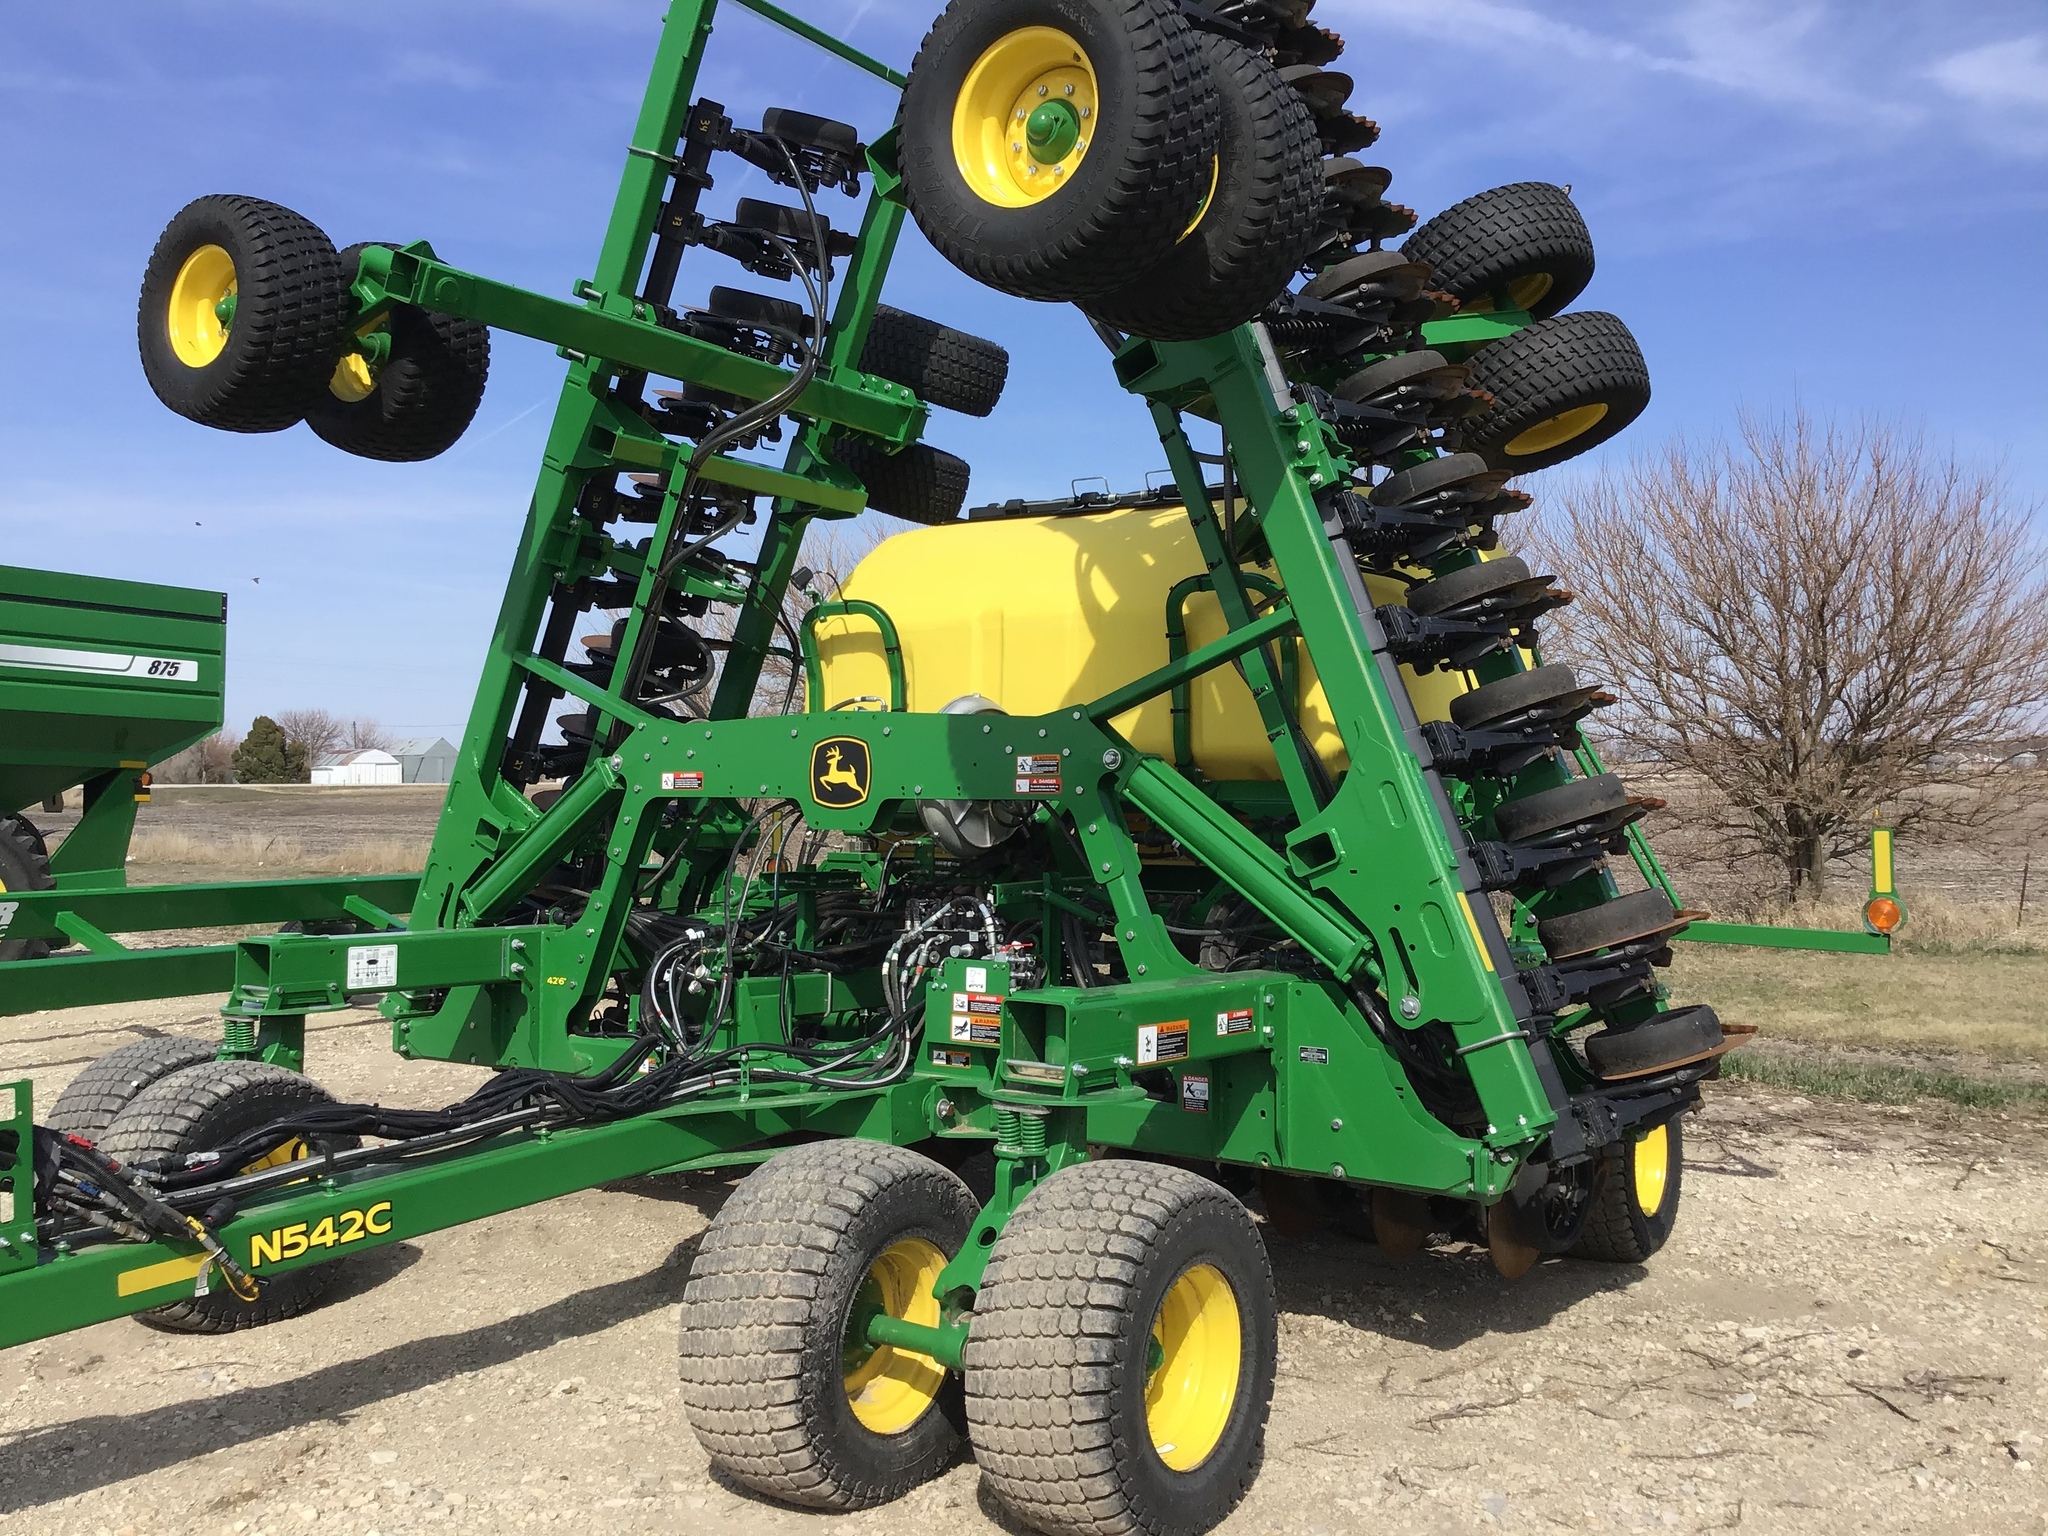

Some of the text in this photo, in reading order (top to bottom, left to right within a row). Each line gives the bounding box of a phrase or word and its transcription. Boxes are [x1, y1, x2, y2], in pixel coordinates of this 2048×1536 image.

[699, 119, 711, 133] 34
[912, 144, 989, 244] TITAN
[672, 215, 684, 227] 33
[148, 660, 181, 676] 875
[1187, 1075, 1209, 1083] DANGER
[250, 1200, 393, 1269] N542C
